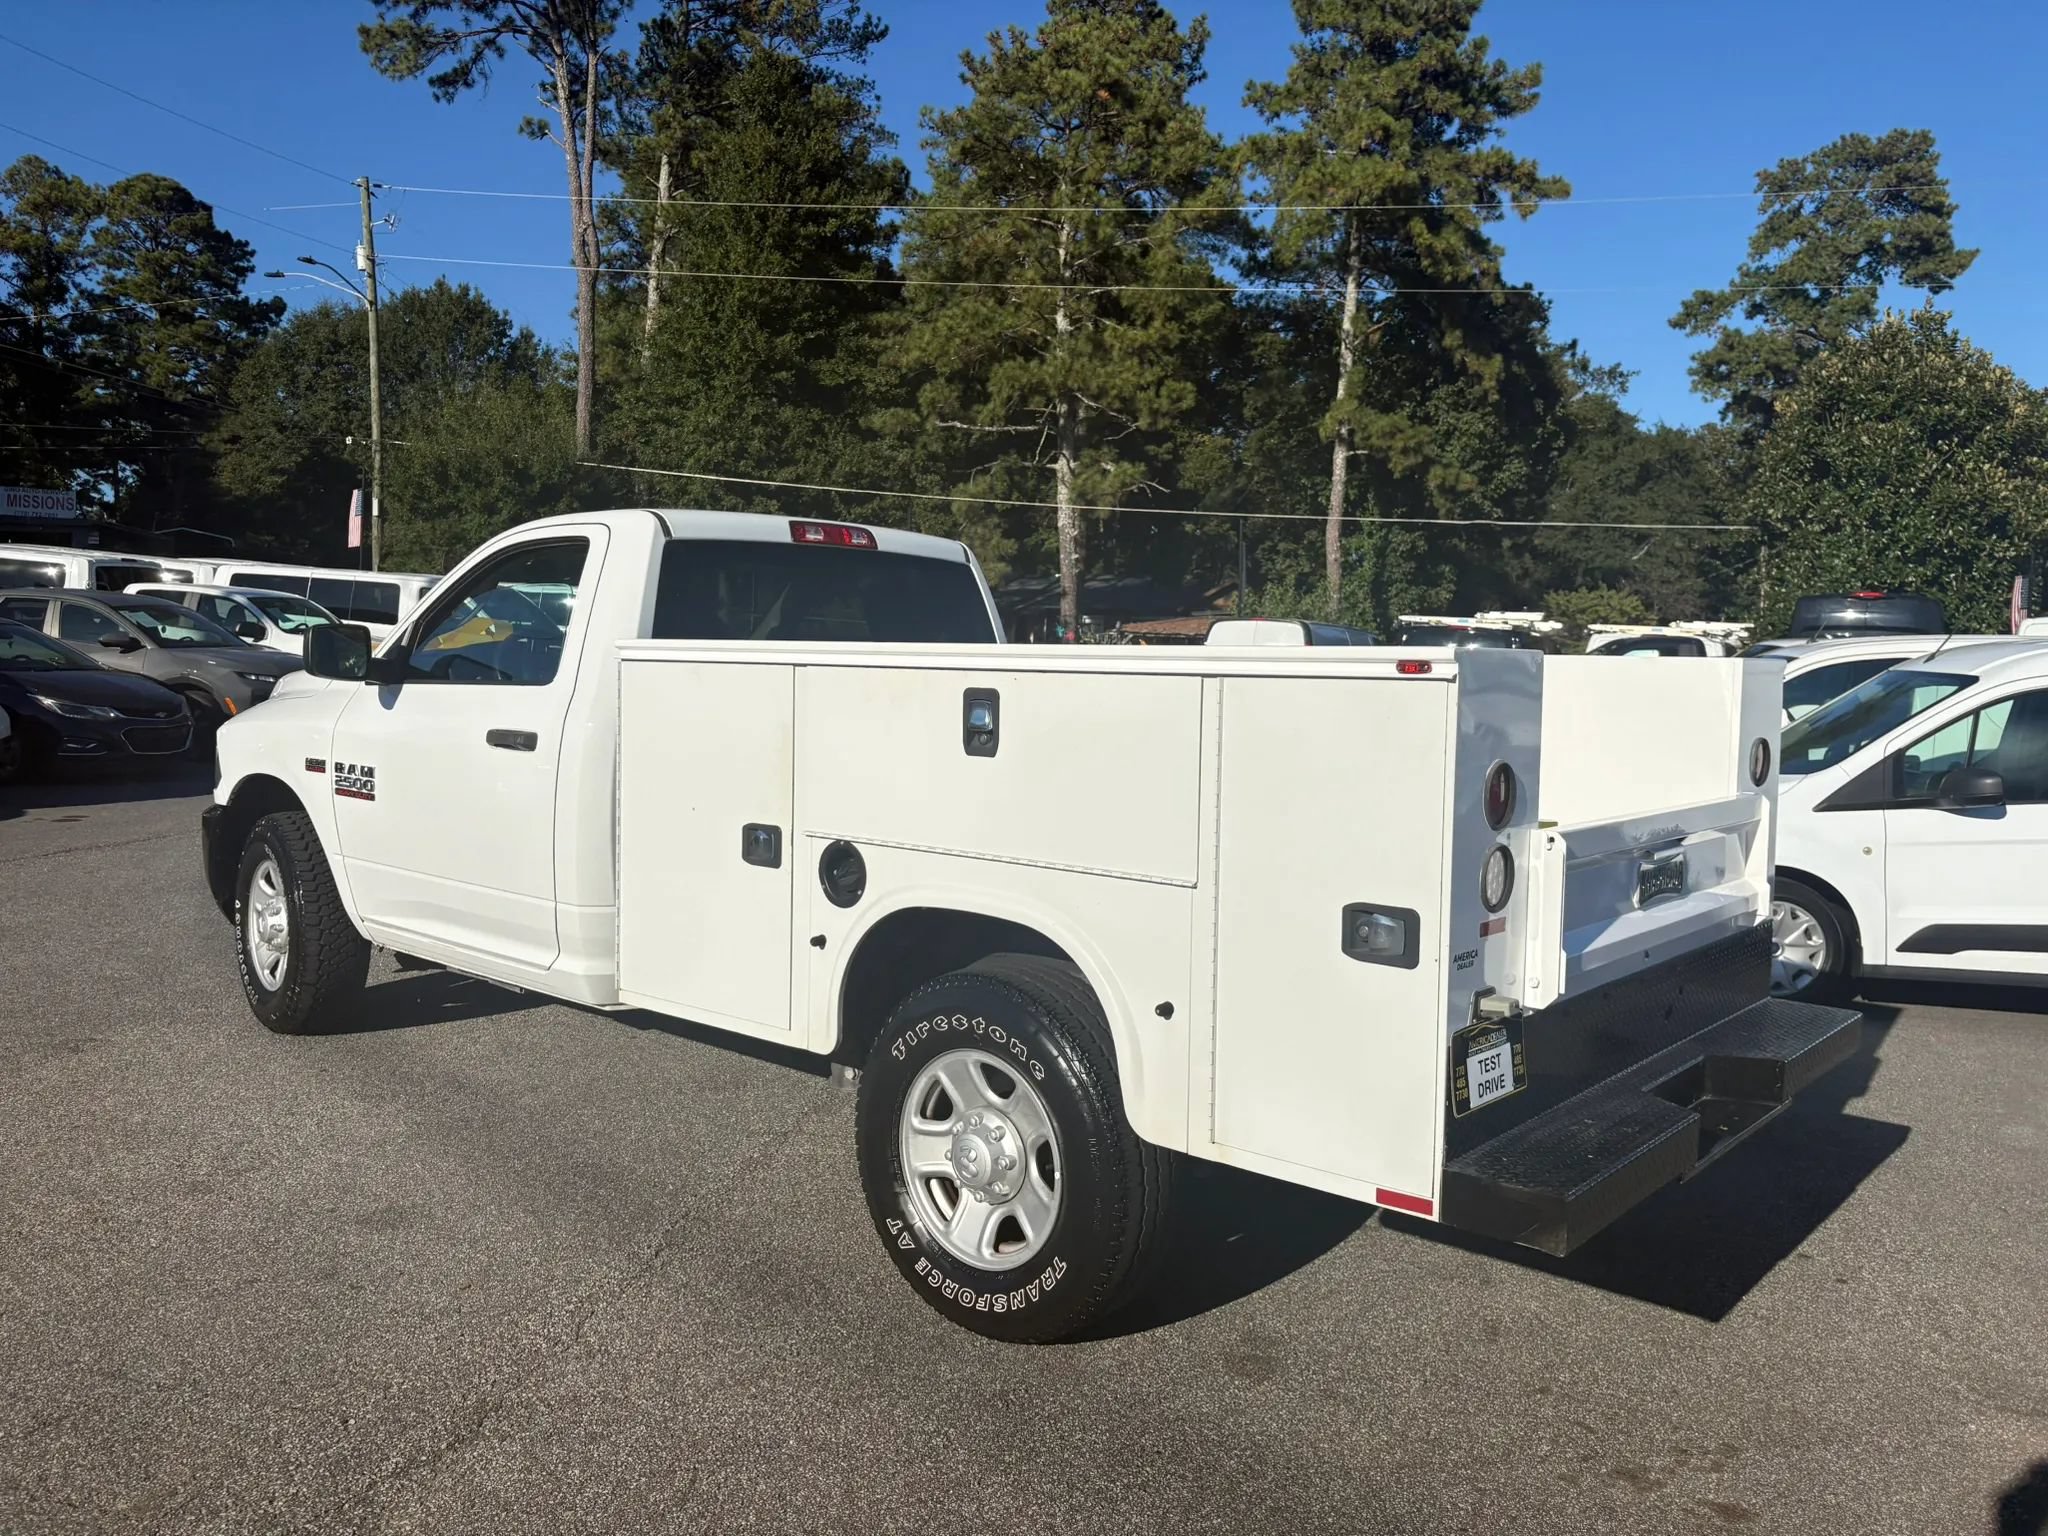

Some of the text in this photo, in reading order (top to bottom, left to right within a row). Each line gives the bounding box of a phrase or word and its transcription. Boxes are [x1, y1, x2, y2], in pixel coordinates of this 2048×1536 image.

[6, 493, 75, 511] MISSIONS
[335, 762, 376, 779] RAM
[335, 775, 376, 792] 2500
[1453, 948, 1478, 964] AMERICA
[1457, 960, 1474, 971] DEALER
[891, 1014, 1045, 1080] Firestone
[1478, 1053, 1501, 1075] TEST
[1478, 1074, 1506, 1098] DRIVE
[886, 1218, 1067, 1312] TRANSFORCE AT
